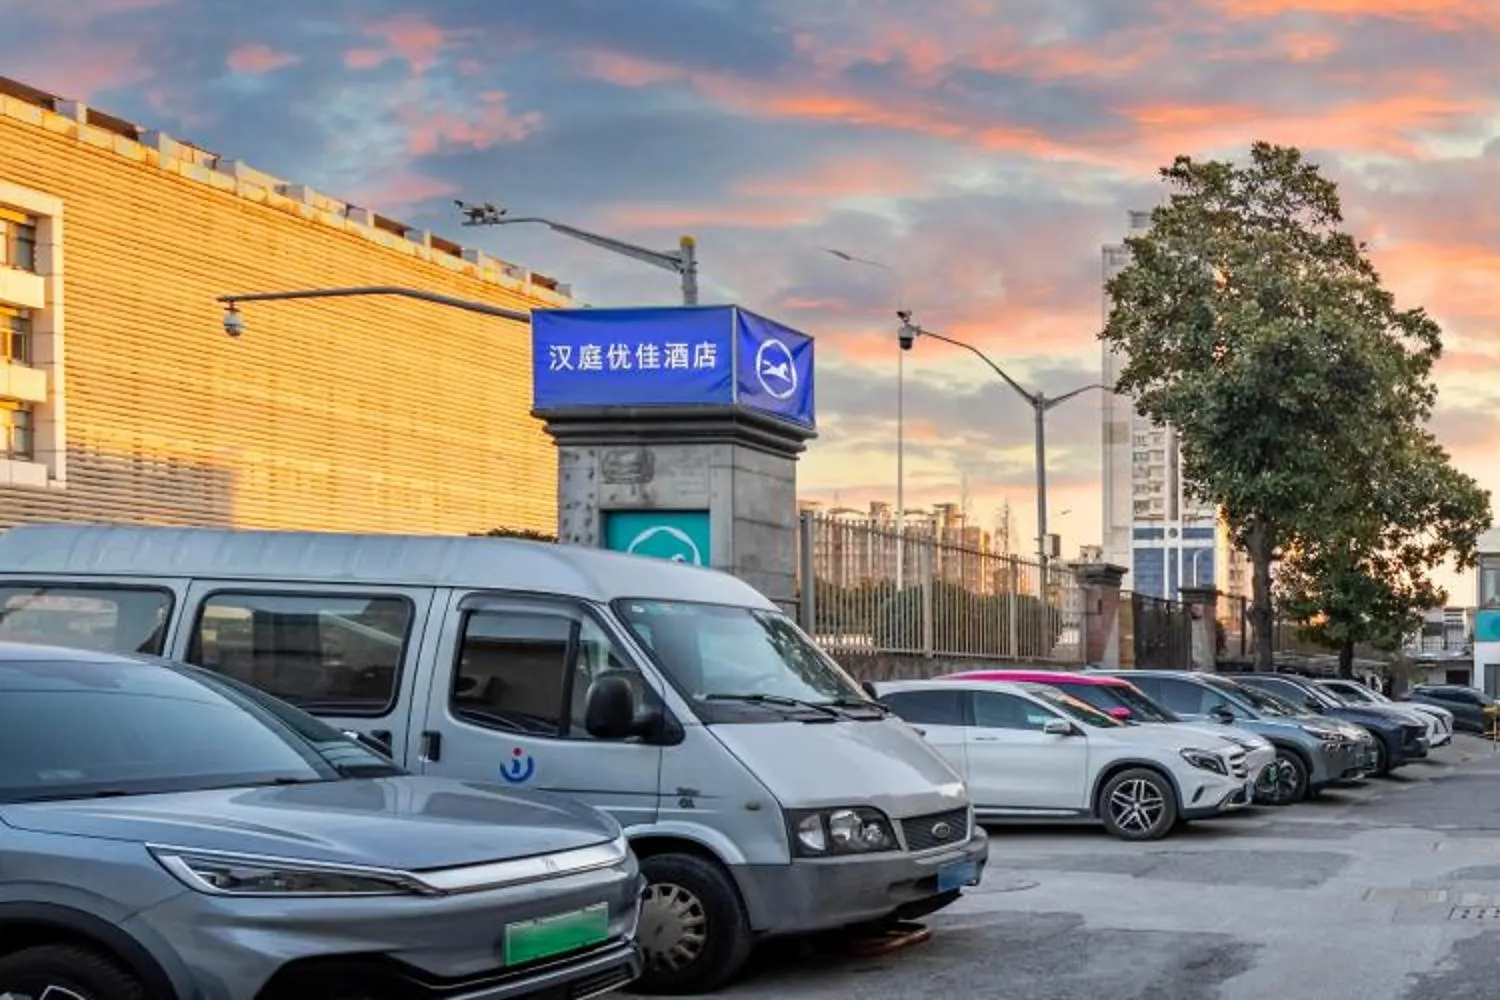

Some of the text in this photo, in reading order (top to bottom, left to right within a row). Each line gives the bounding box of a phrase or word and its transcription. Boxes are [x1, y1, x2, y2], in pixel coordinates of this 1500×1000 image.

[549, 342, 717, 371] 汉庭优佳酒店
